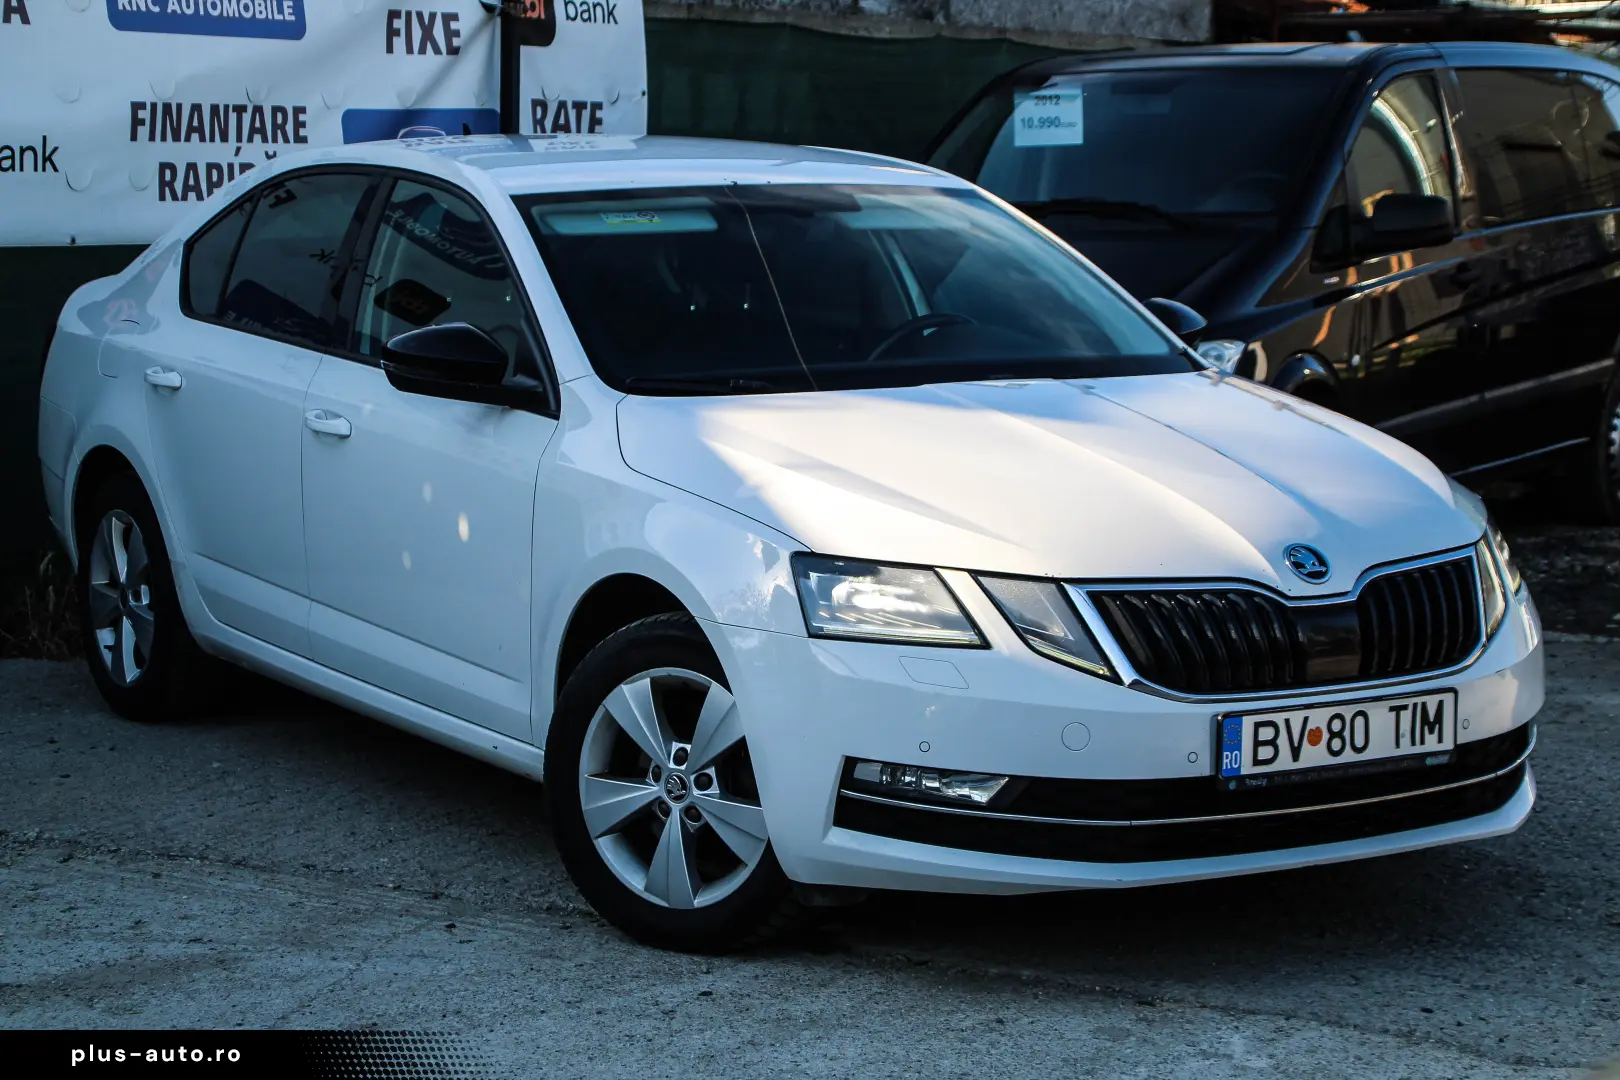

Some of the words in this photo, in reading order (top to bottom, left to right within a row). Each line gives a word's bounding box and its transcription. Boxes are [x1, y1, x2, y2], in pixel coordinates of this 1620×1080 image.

[167, 0, 296, 20] AUTOMOBILE
[565, 0, 619, 24] bank
[386, 9, 460, 55] FIXE
[1034, 95, 1060, 106] 2012
[531, 98, 604, 134] RATE
[1020, 116, 1060, 129] 10.990
[130, 101, 308, 157] FINANȚARE
[1252, 716, 1309, 767] BV
[1326, 709, 1370, 757] 80
[1389, 699, 1444, 749] TIM
[1223, 751, 1240, 769] RO
